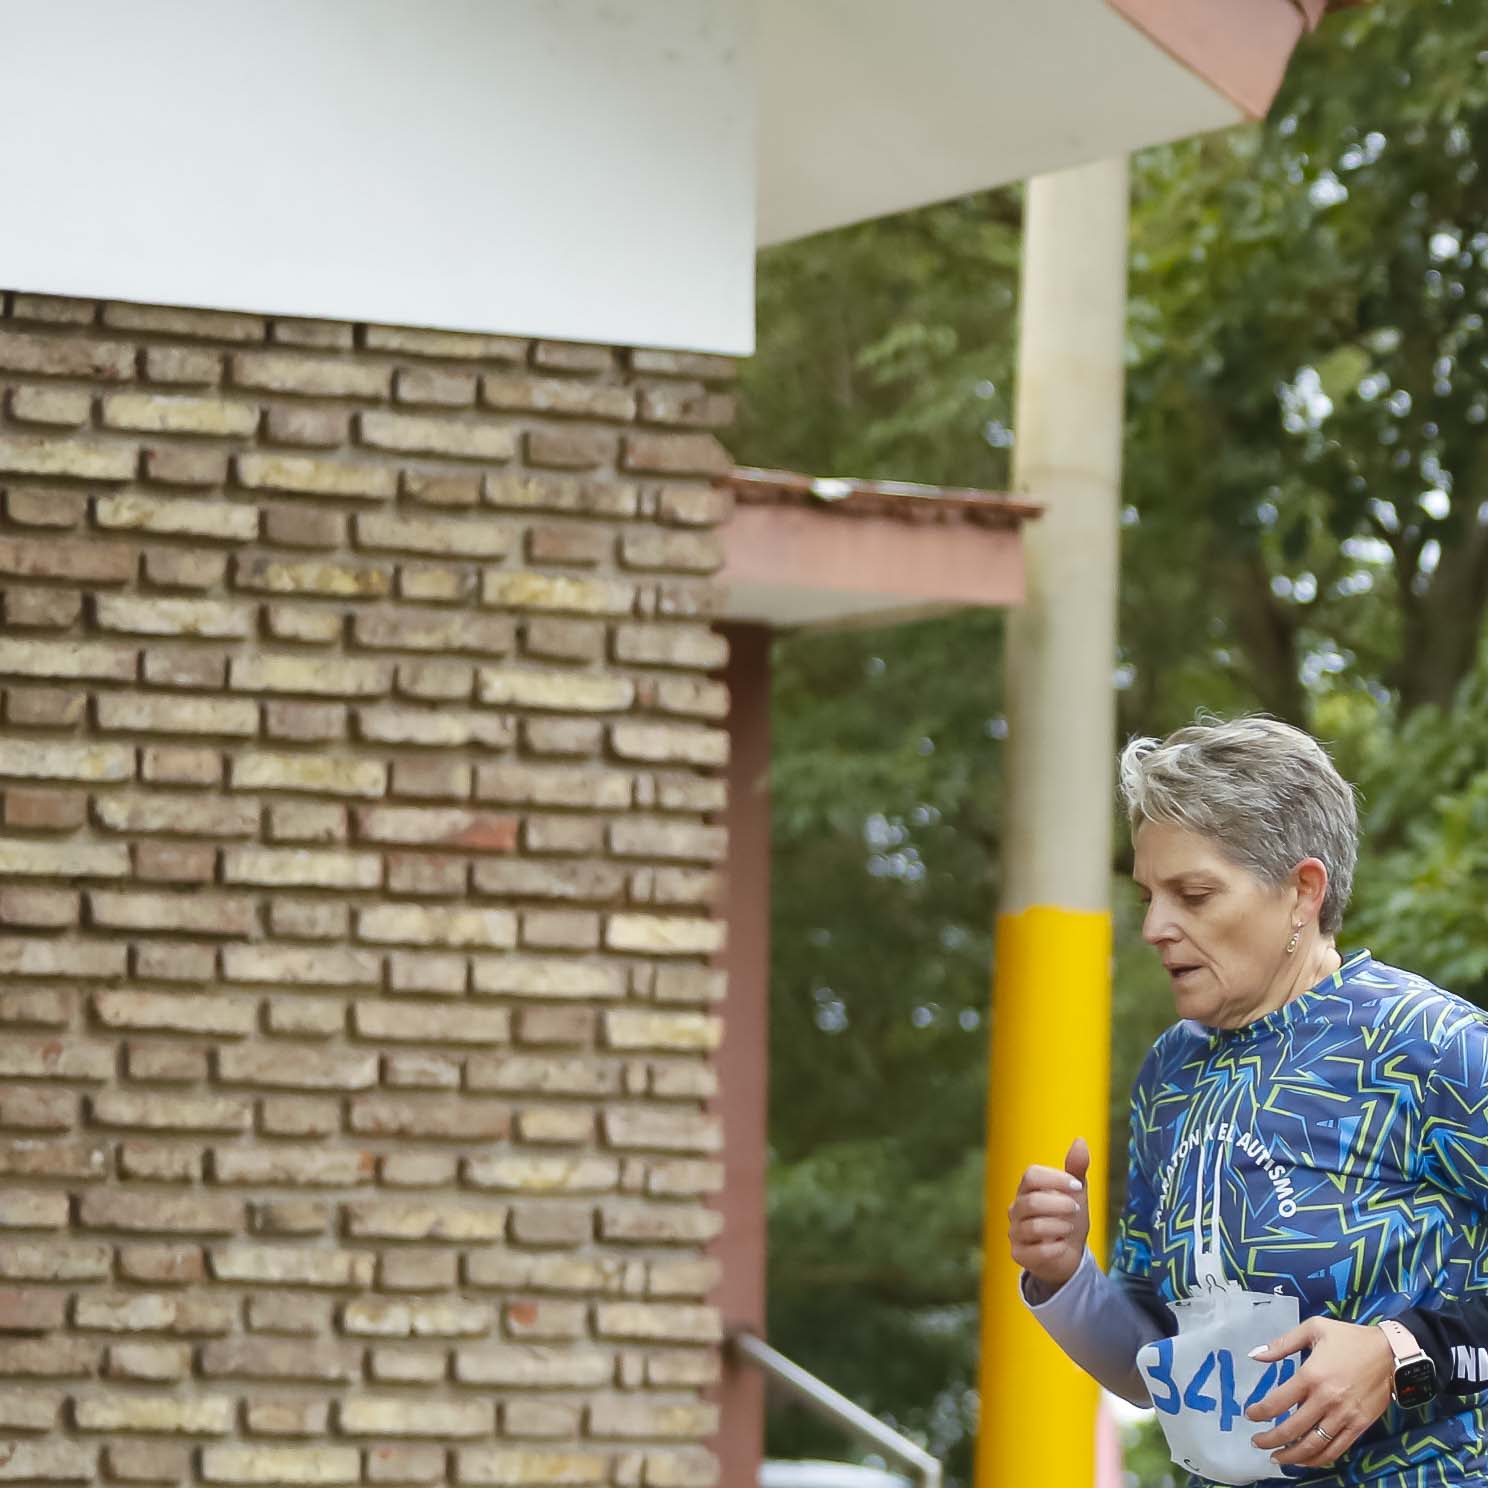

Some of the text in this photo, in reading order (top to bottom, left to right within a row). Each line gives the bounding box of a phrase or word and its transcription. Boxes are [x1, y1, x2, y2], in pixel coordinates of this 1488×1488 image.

[1154, 1123, 1298, 1230] MARATON X EL AUTISMO
